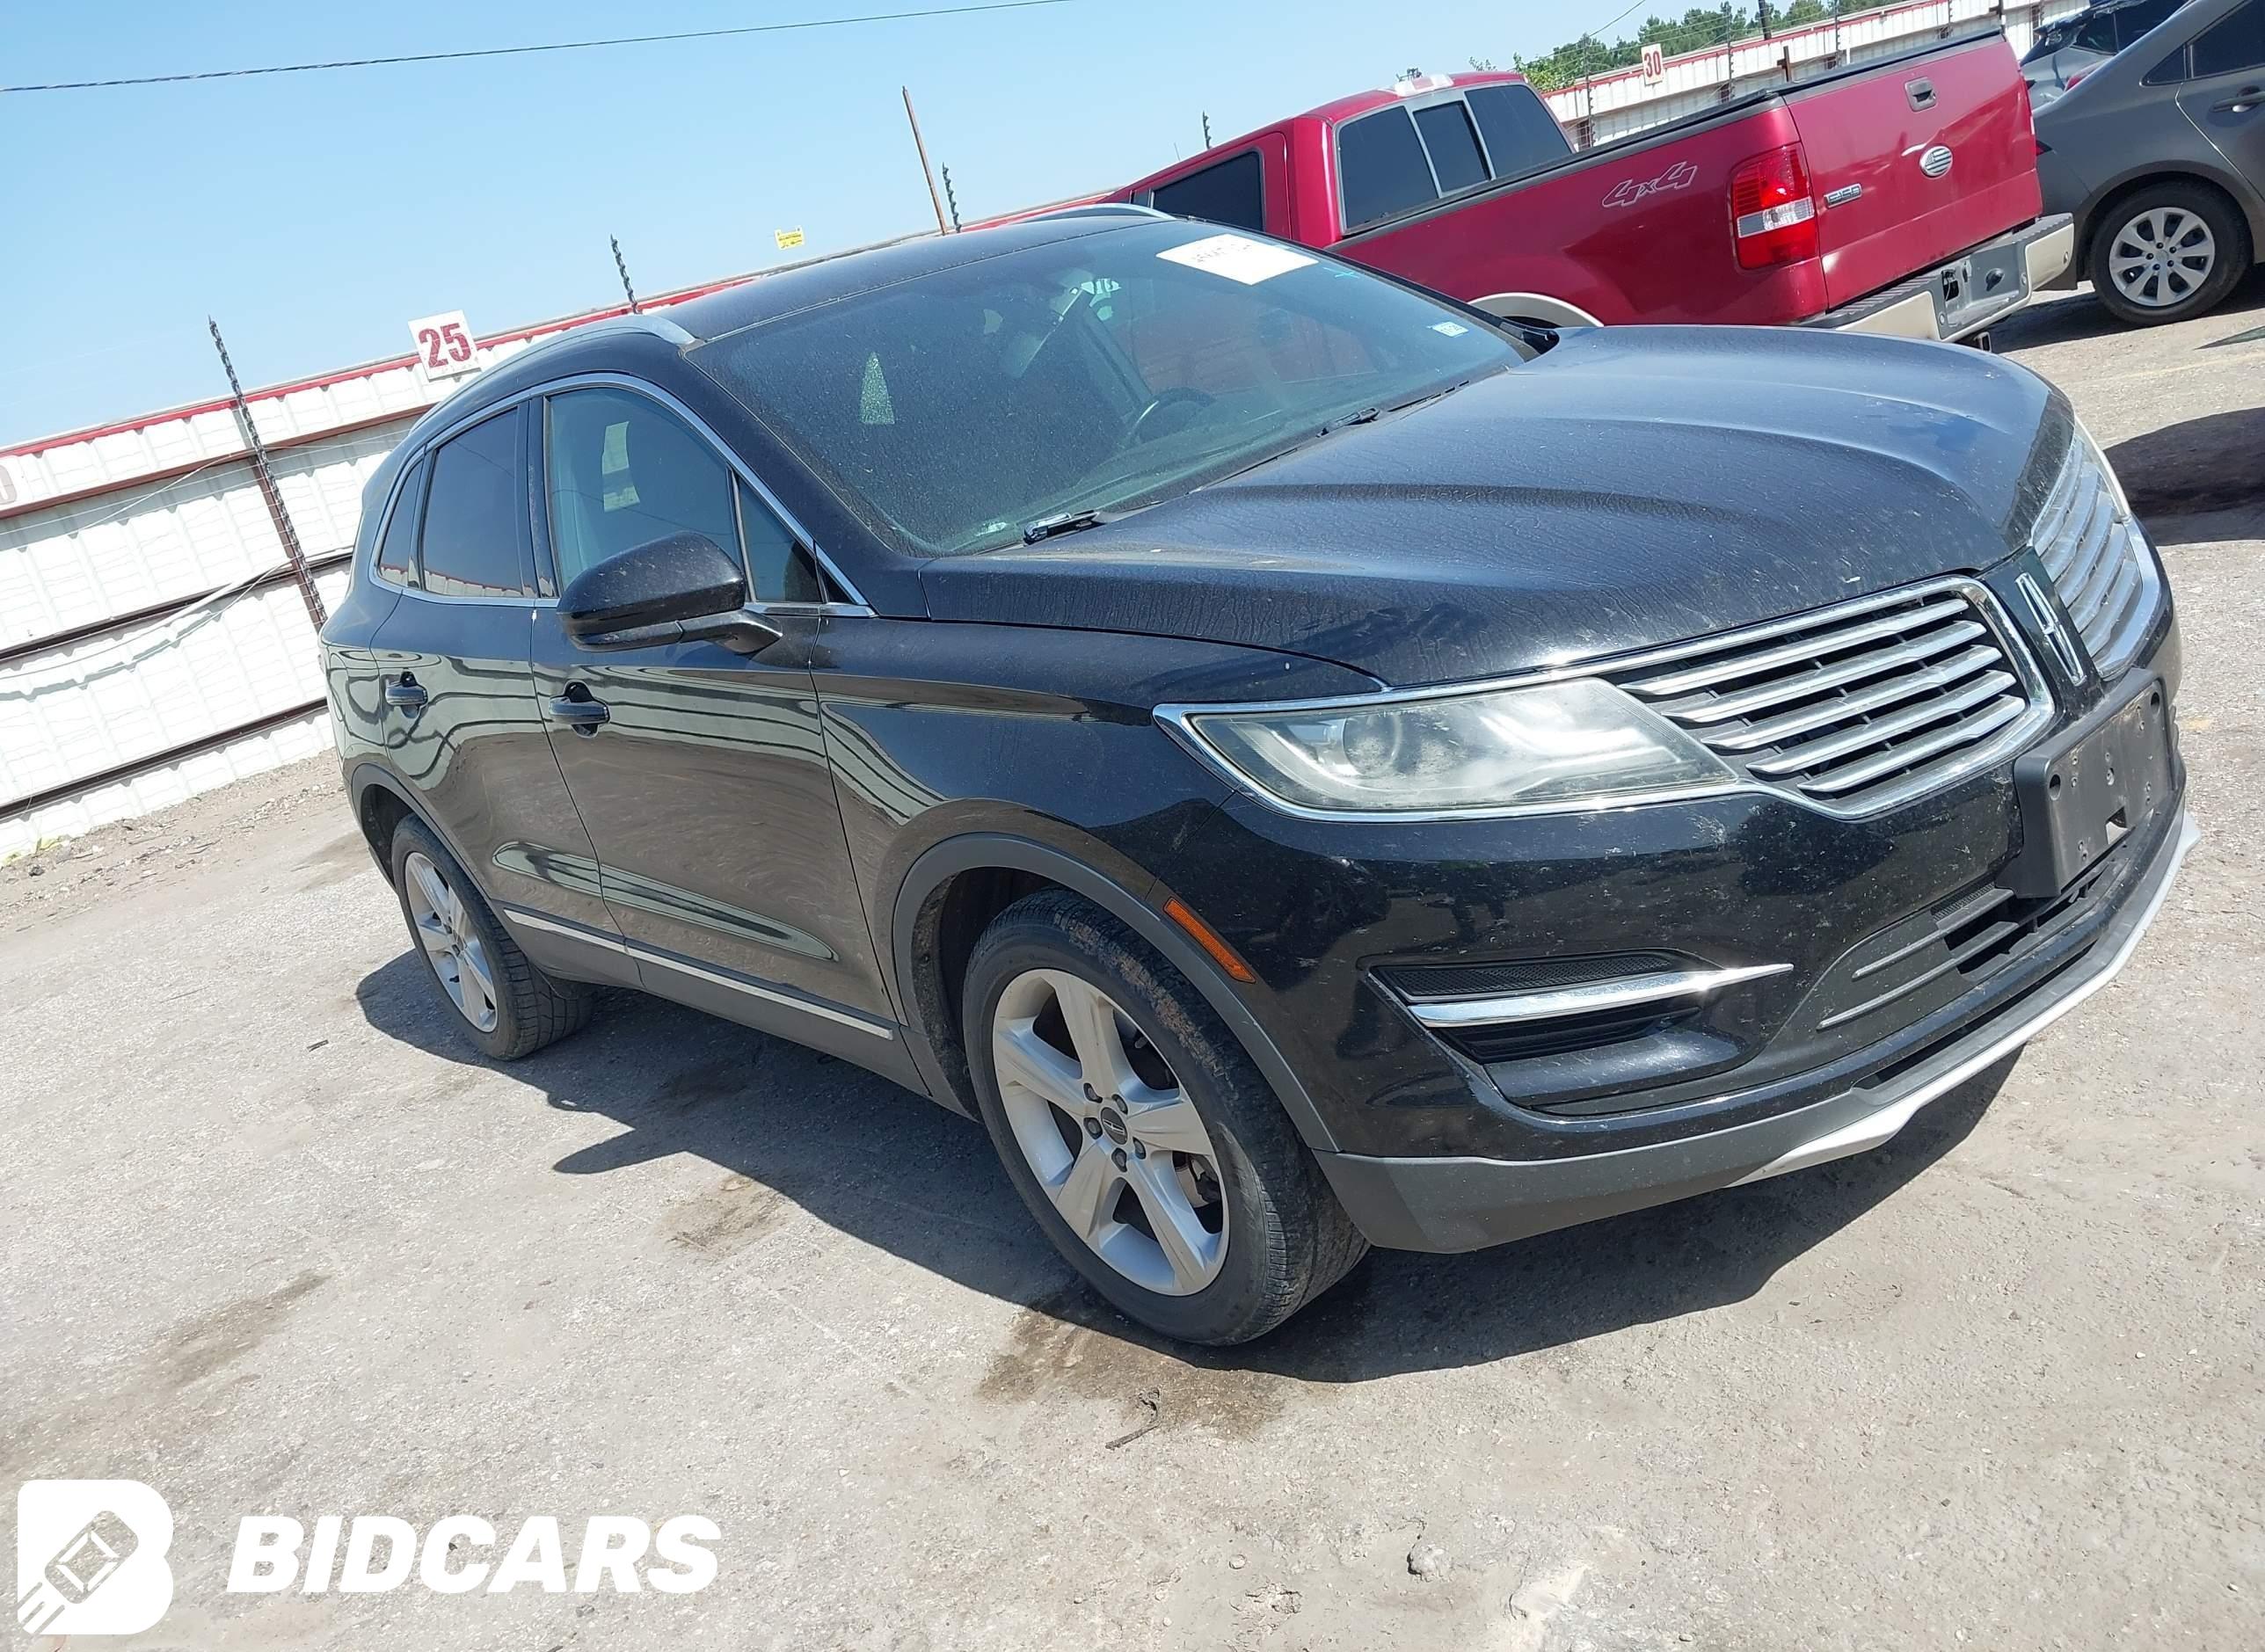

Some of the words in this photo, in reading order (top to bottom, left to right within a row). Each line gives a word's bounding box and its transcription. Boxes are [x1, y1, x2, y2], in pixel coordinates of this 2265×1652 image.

[1644, 51, 1661, 77] 30
[1602, 161, 1698, 207] 4x4
[419, 323, 471, 368] 25
